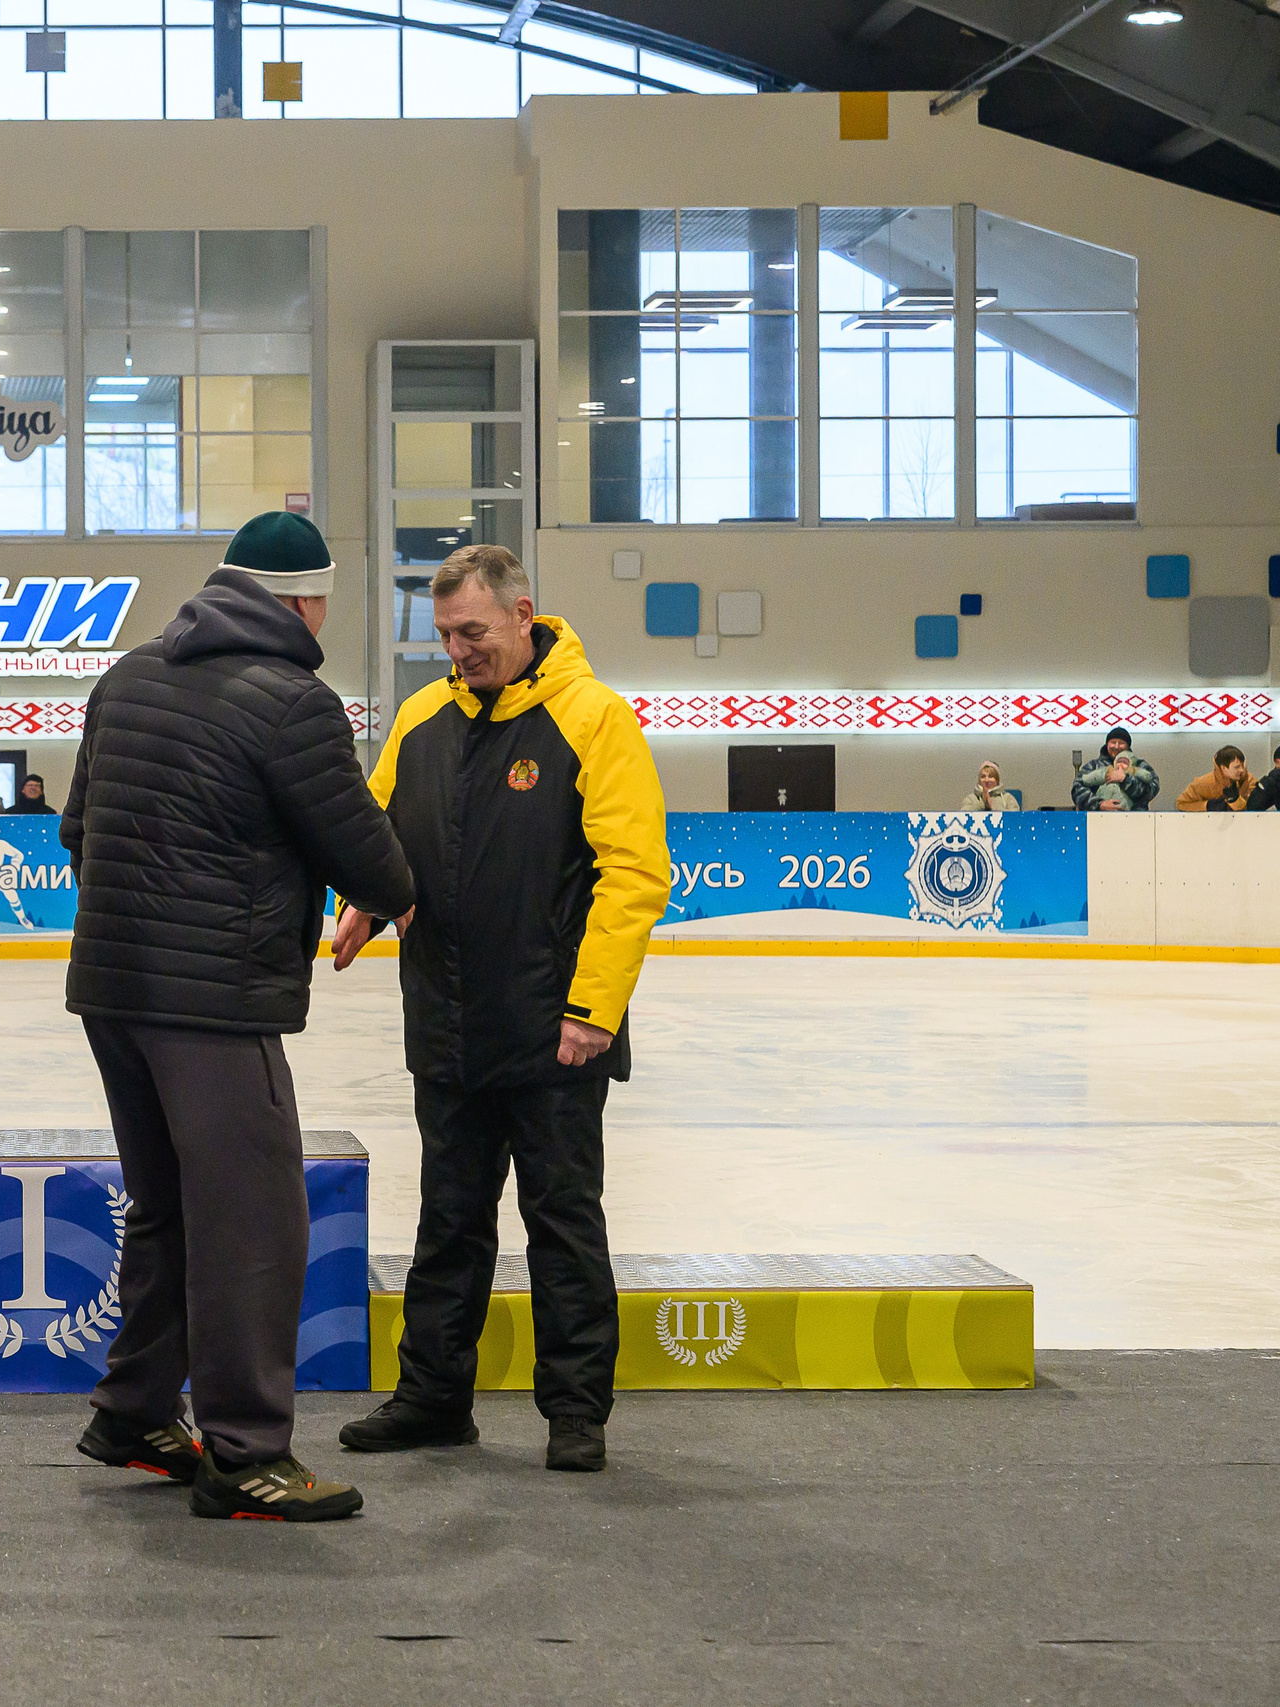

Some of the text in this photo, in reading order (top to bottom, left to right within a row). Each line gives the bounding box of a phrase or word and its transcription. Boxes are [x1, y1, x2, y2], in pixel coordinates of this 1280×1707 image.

[778, 854, 872, 890] 2026
[1, 1166, 67, 1309] I
[671, 1301, 731, 1340] III
